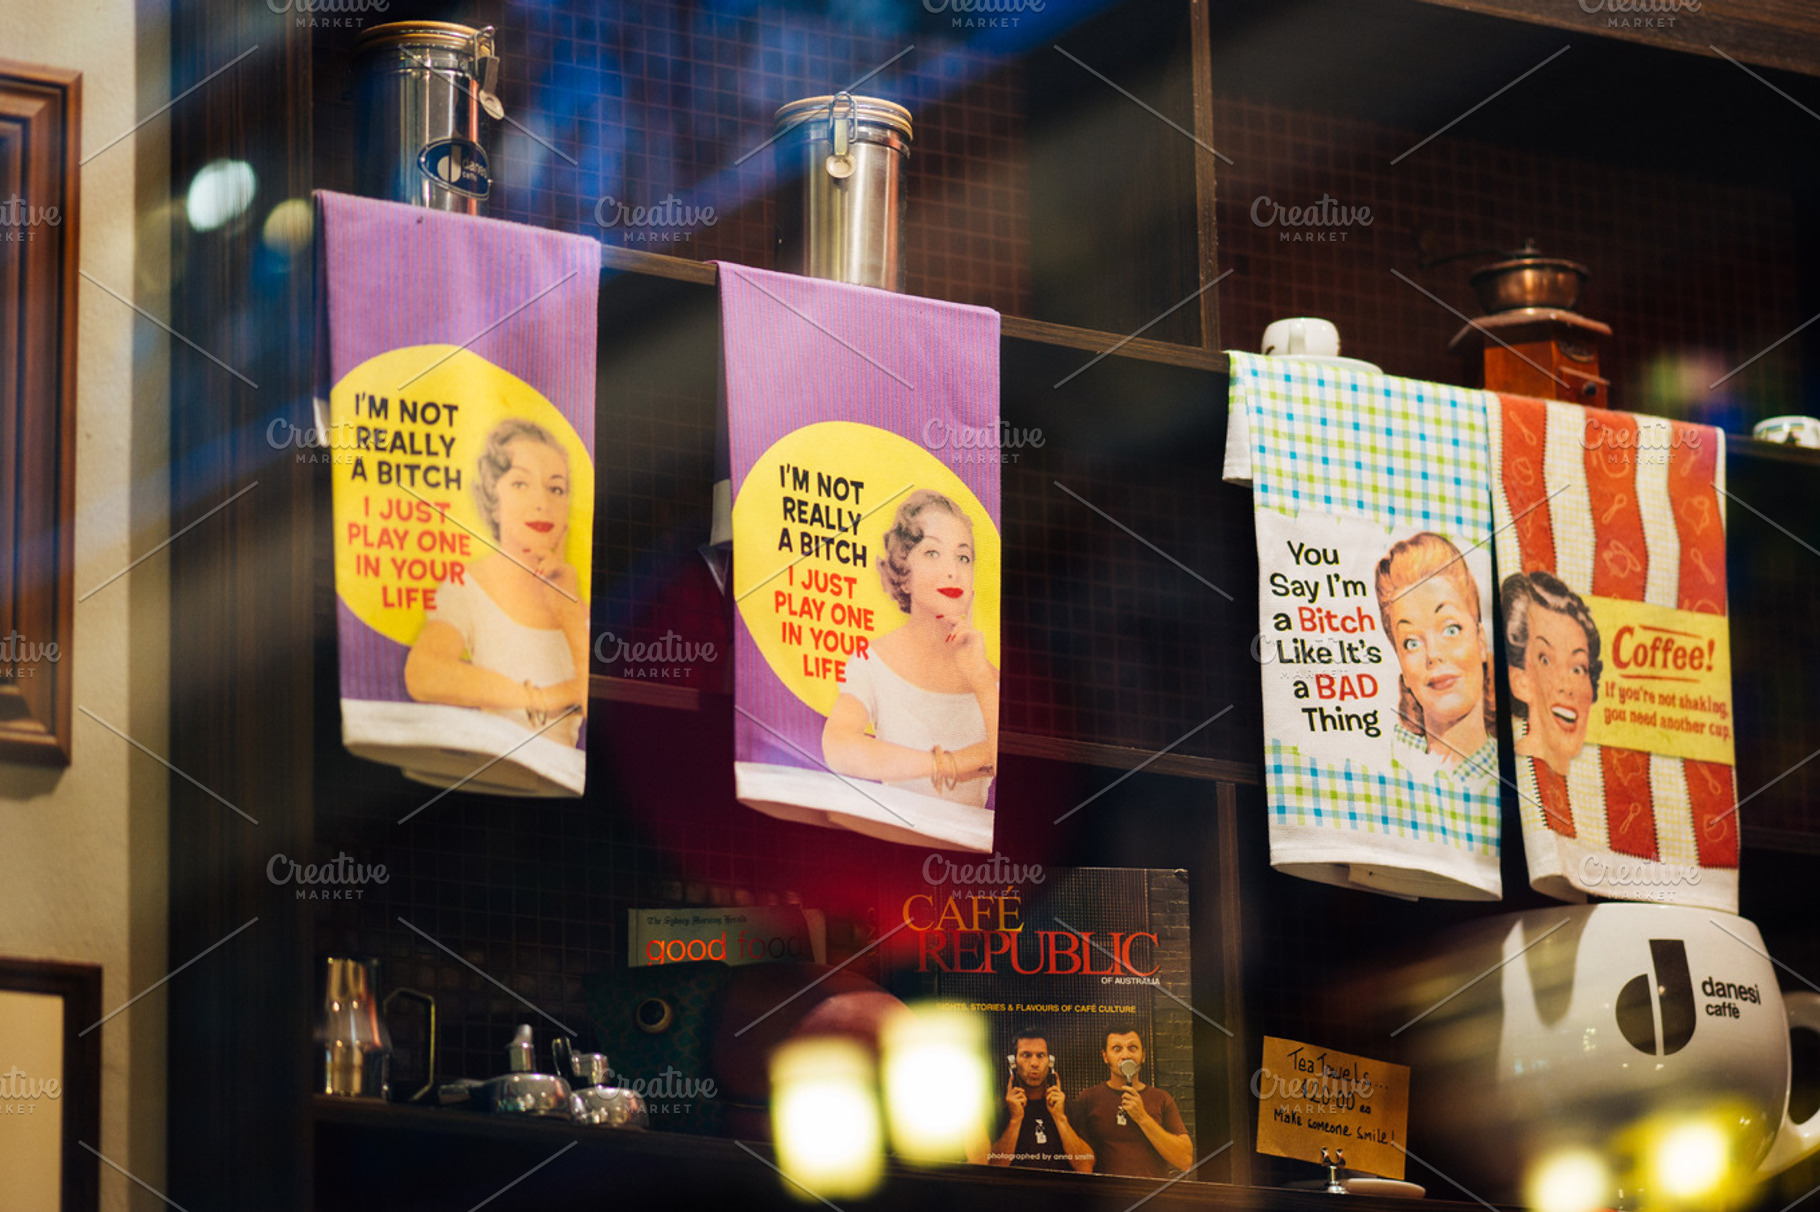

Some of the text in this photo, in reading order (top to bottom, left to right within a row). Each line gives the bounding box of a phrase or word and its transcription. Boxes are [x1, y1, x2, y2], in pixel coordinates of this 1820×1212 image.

[355, 392, 459, 427] I'M NOT
[356, 426, 456, 458] REALLY
[351, 458, 462, 491] A BITCH
[780, 463, 864, 505] I'M NOT
[364, 496, 451, 524] I JUST
[783, 496, 862, 536] REALLY
[348, 522, 472, 556] PLAY ONE
[778, 527, 867, 568] A BITCH
[1287, 540, 1340, 566] You
[356, 554, 465, 586] IN YOUR
[788, 565, 857, 600] I JUST
[382, 586, 437, 610] LIFE
[1270, 572, 1367, 604] Say I'm
[774, 590, 875, 631] PLAY ONE
[1273, 606, 1376, 634] a Bitch
[781, 622, 870, 661] IN YOUR
[1276, 638, 1382, 665] Like It's
[1612, 625, 1715, 672] Coffee!
[803, 654, 847, 683] LIFE
[1293, 673, 1379, 701] a BAD
[1605, 681, 1616, 698] If
[1619, 686, 1656, 704] you're
[1658, 692, 1677, 708] not
[1301, 706, 1382, 738] Thing
[1604, 708, 1626, 725] you
[1630, 711, 1657, 727] need
[1660, 715, 1706, 735] another
[902, 886, 1024, 932] CAFÉ
[646, 931, 727, 966] good
[914, 930, 1161, 977] REPUBLIC
[1101, 977, 1160, 986] OF AUSTRALIA
[1702, 976, 1761, 1005] danesi
[970, 1003, 1006, 1012] STORIES
[1008, 1003, 1014, 1012] &
[1016, 1003, 1059, 1012] FLAVOURS
[1061, 1004, 1074, 1012] OF
[1075, 1003, 1097, 1013] CAFÉ
[1099, 1004, 1136, 1014] CULTURE
[1705, 1001, 1740, 1019] caffè
[1287, 1047, 1315, 1073] Tea
[987, 1152, 1040, 1161] photographed
[1042, 1153, 1051, 1161] by
[1075, 1153, 1095, 1161] smith
